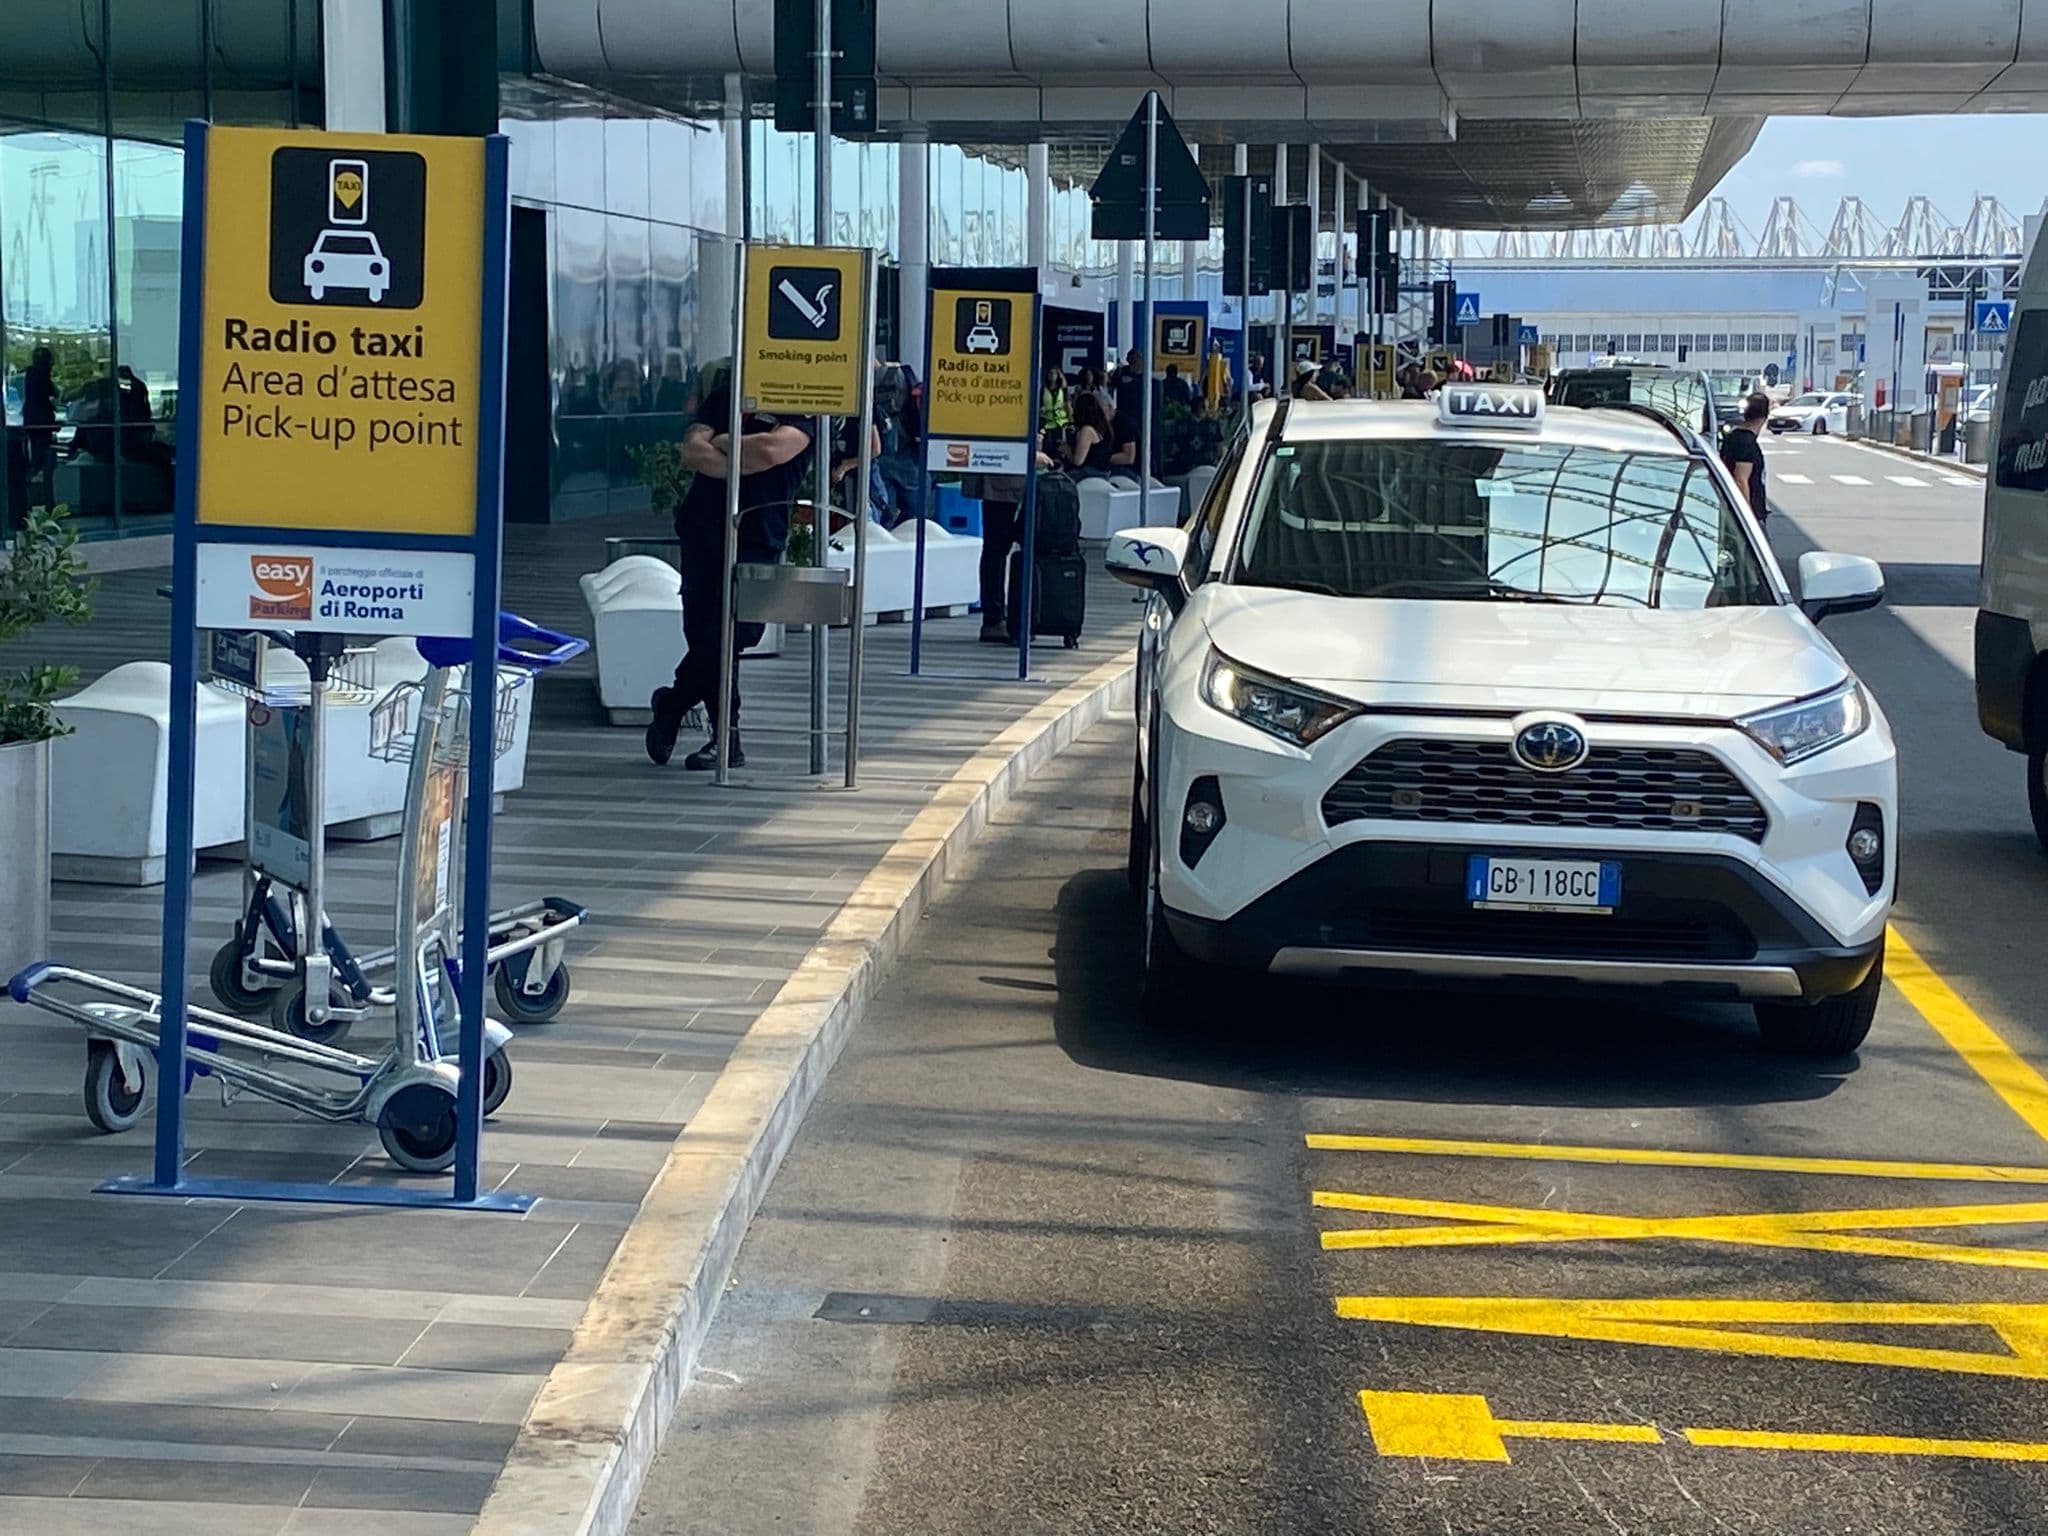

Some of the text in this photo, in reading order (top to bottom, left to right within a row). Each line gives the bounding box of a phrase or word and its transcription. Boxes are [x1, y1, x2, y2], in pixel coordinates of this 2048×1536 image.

[337, 180, 361, 191] TAXI
[225, 318, 423, 357] Radio taxi
[758, 349, 848, 364] Smoking point
[937, 358, 1010, 374] Radio taxi
[222, 362, 455, 402] Area d'attesa
[936, 375, 967, 388] Area
[936, 389, 1024, 408] Pick-up point
[1453, 391, 1530, 414] TAXI
[223, 404, 462, 451] Pick-up point
[255, 563, 310, 587] easy
[320, 579, 424, 603] Aeroporti
[320, 600, 404, 620] di Roma
